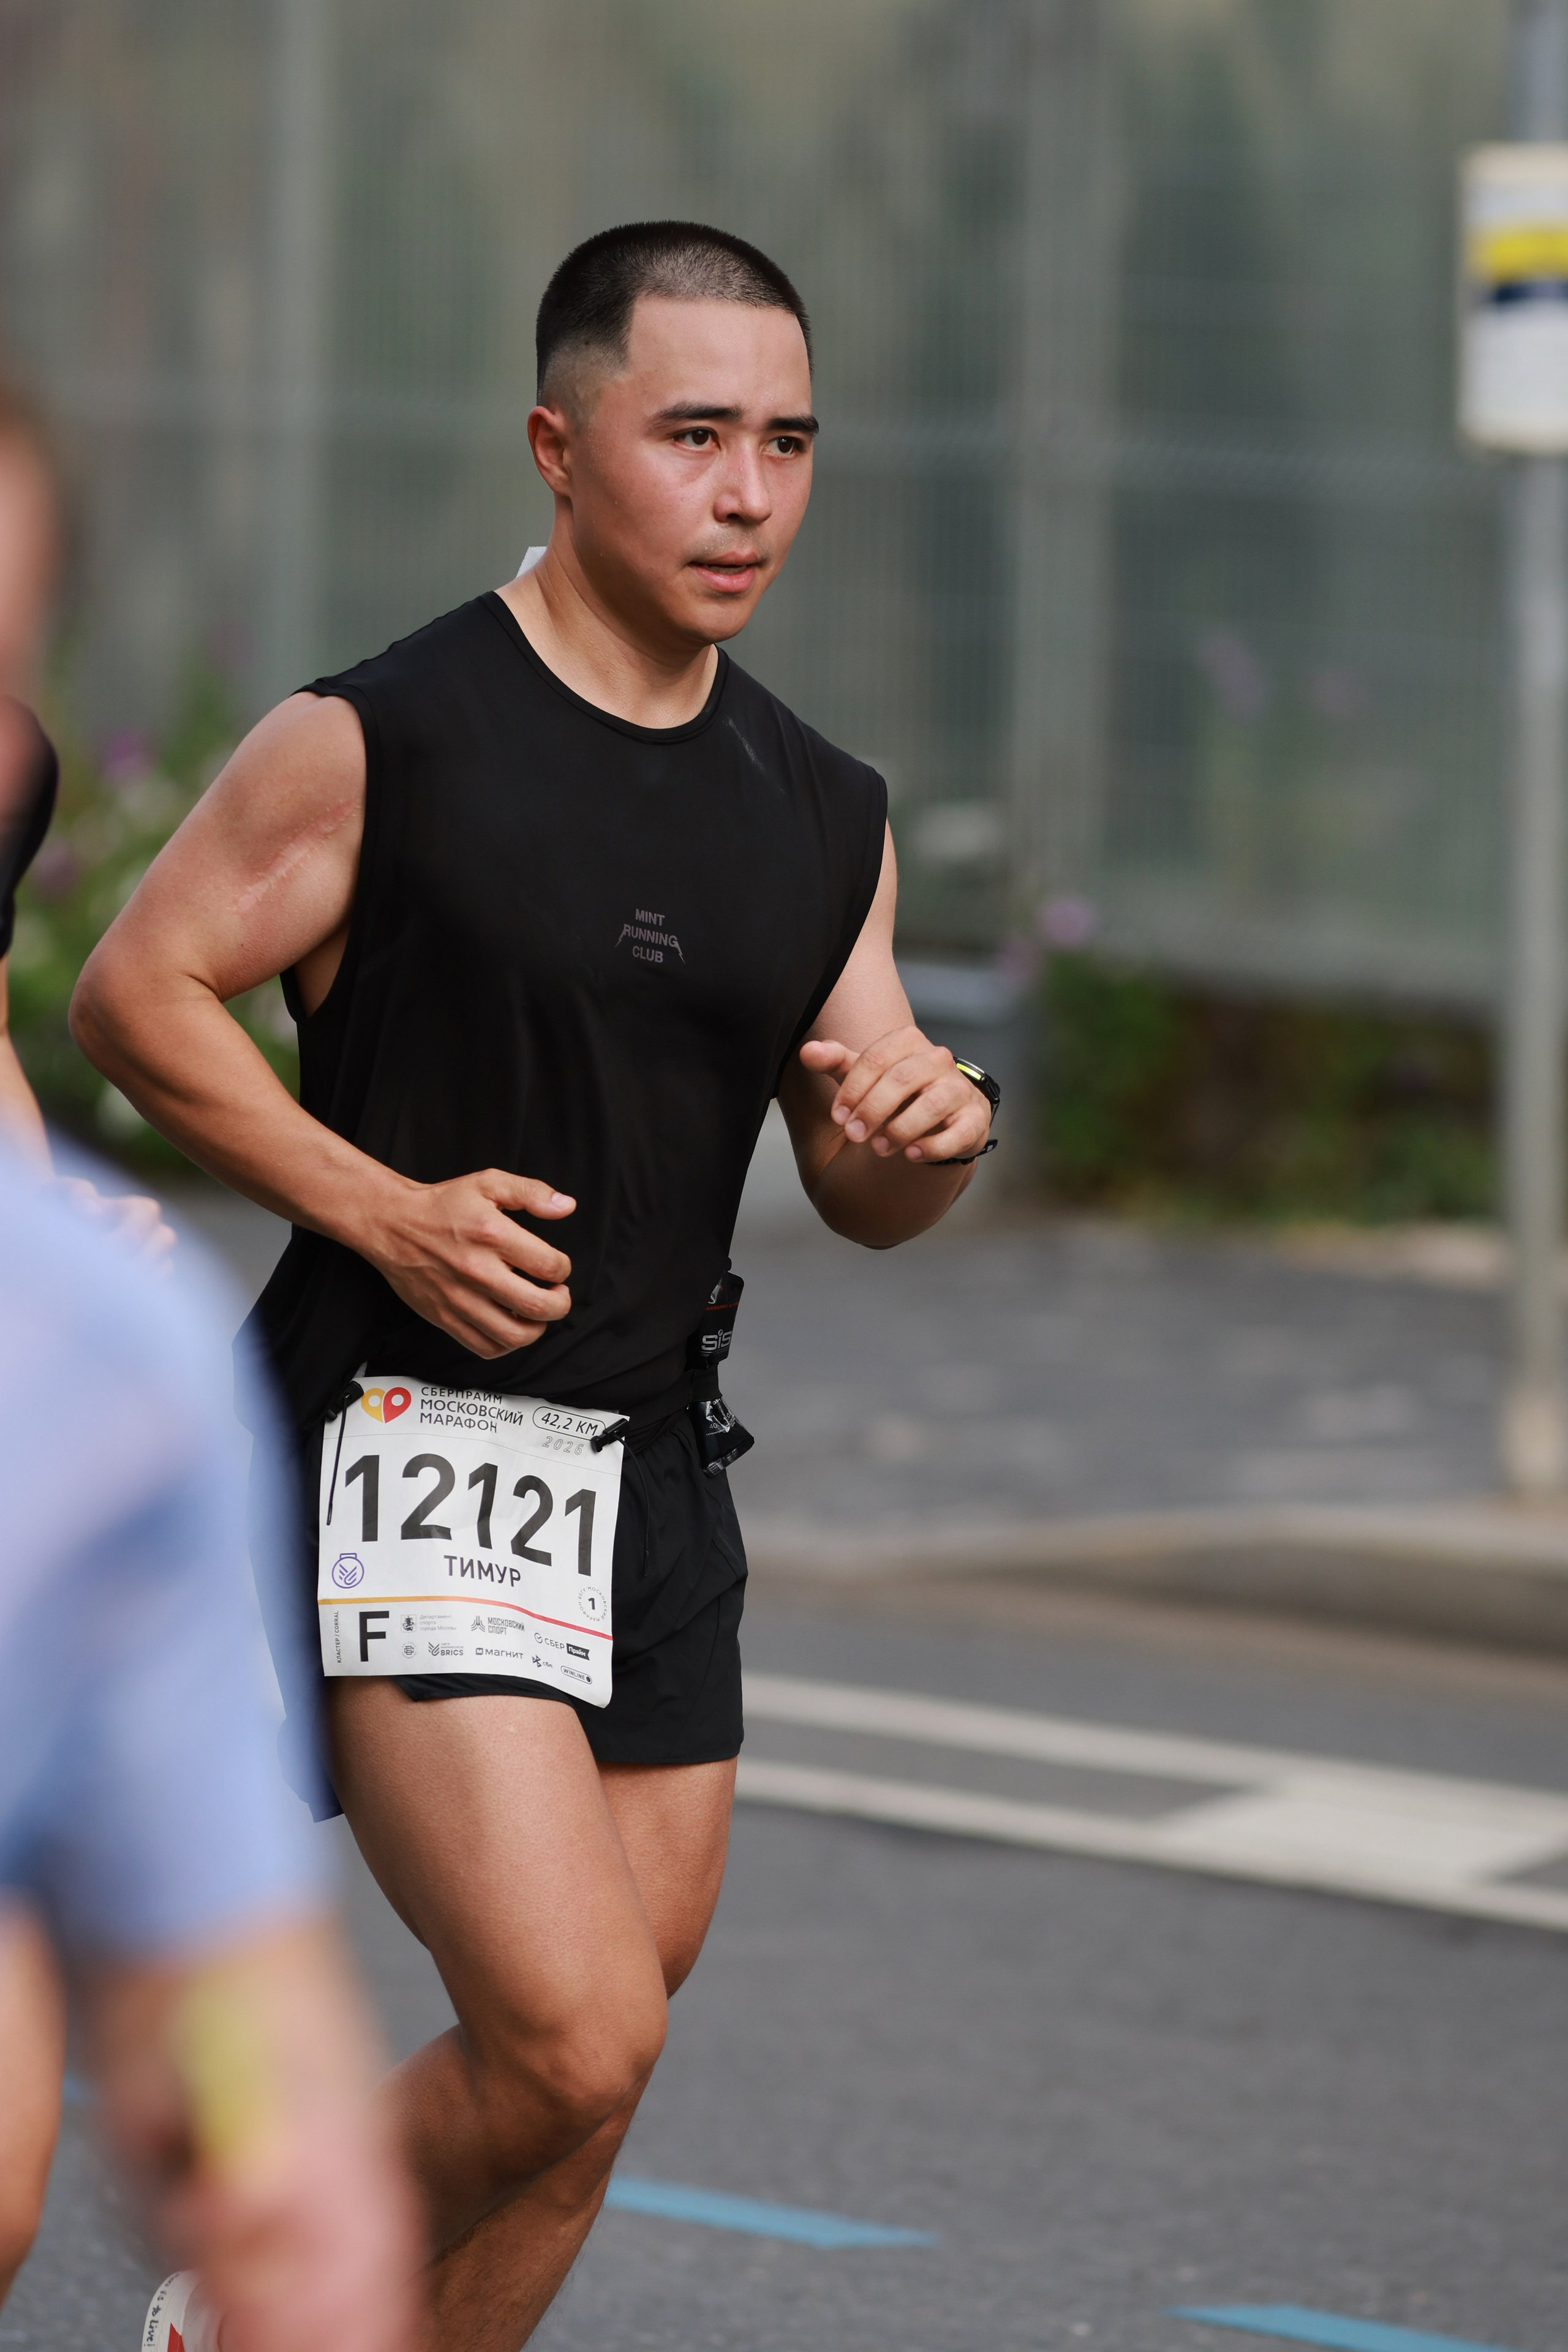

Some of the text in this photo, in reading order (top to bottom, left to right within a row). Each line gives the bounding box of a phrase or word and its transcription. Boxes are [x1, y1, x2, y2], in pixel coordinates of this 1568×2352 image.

[636, 908, 665, 926] MINT
[619, 924, 682, 953] RUNNING
[632, 946, 663, 963] CLUB
[421, 1387, 502, 1404] СБЕРПРАЙМ
[421, 1399, 523, 1425] МОСКОВСКИЙ
[541, 1412, 573, 1430] 42,2
[420, 1412, 497, 1433] МАРАФОН
[542, 1436, 584, 1455] 2026
[345, 1453, 596, 1577] 12121
[443, 1555, 521, 1587] ТИМУР
[579, 1602, 600, 1621] МАРАФОН
[587, 1586, 607, 1620] МОСКОВСКИЙ
[588, 1597, 595, 1610] 1
[488, 1617, 525, 1632] МОСКОВСКИЙ
[488, 1625, 507, 1635] СПОРТ
[359, 1611, 389, 1662] F
[485, 1648, 523, 1659] магнит
[545, 1638, 586, 1657] СБЕР Прайм
[563, 1667, 586, 1680] WINLINE
